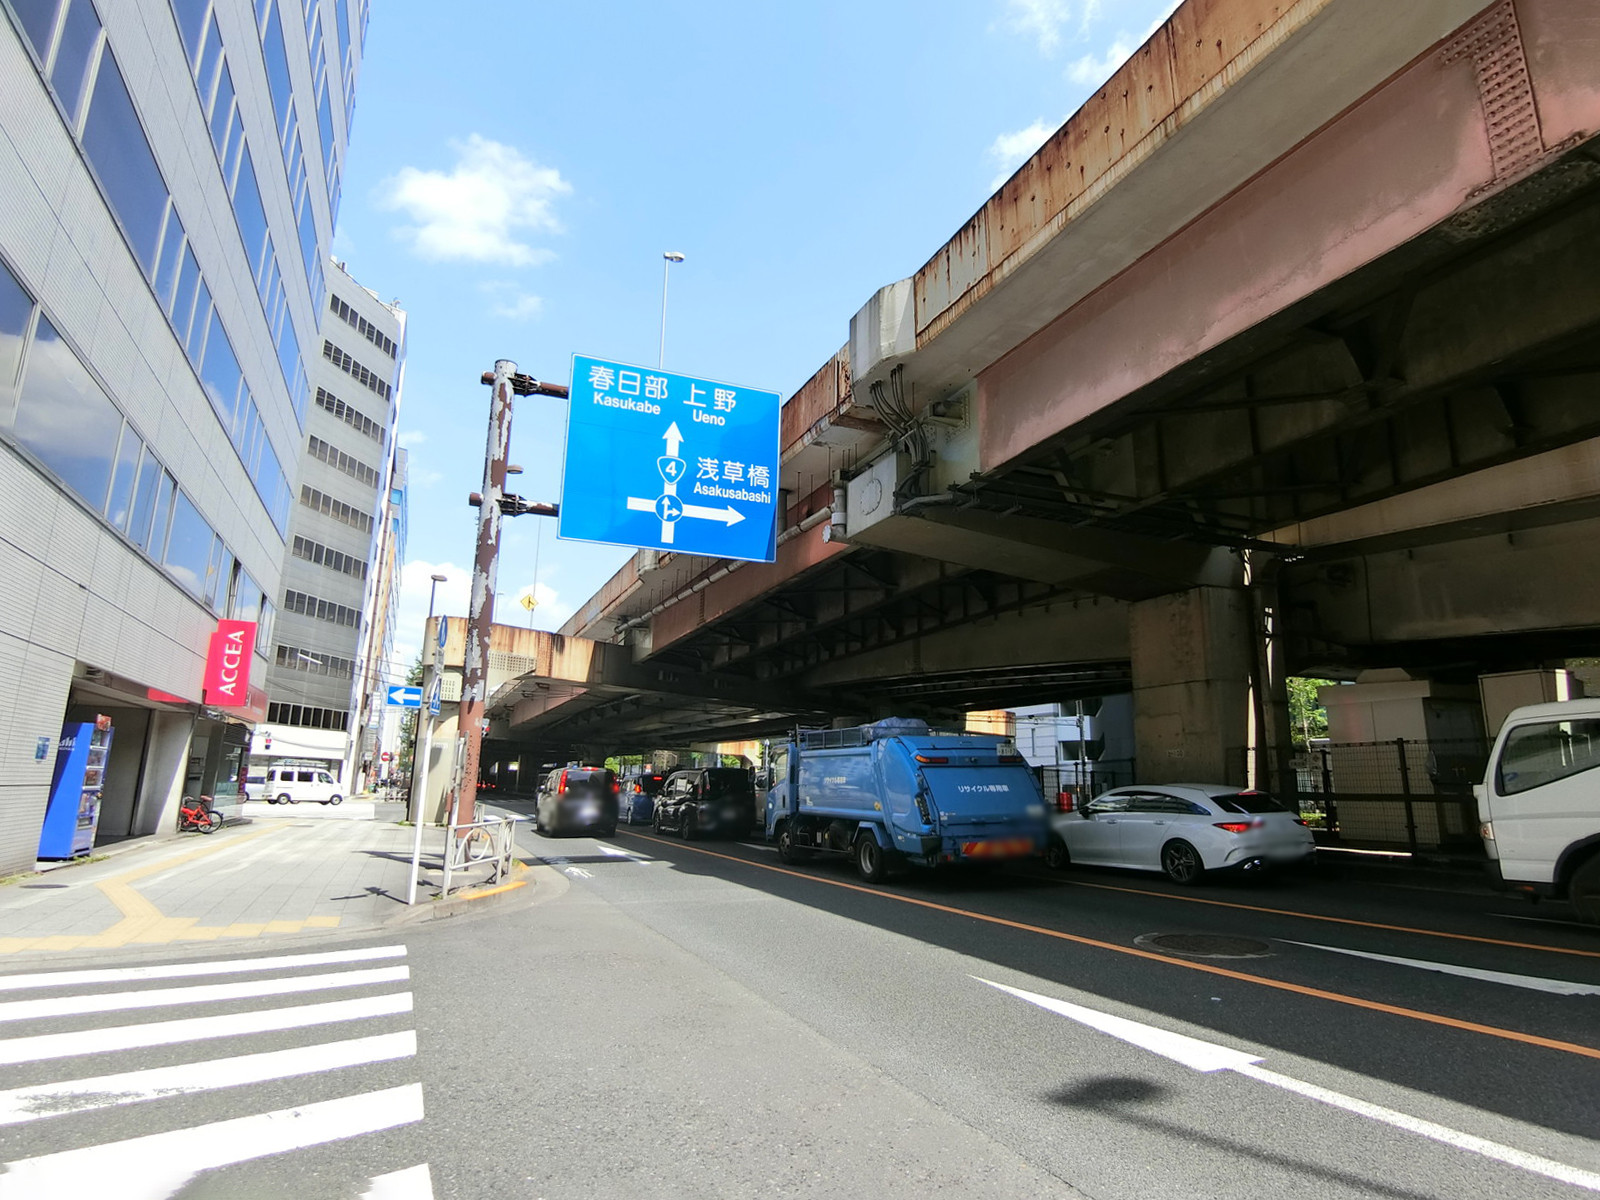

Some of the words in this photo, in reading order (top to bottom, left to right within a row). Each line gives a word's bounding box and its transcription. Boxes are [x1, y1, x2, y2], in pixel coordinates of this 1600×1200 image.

[588, 365, 668, 400] 春日部
[593, 391, 661, 415] Kasukabe
[683, 383, 736, 412] 上野
[692, 409, 726, 426] Ueno
[665, 460, 677, 477] 4
[696, 457, 770, 488] 浅草橋
[693, 481, 771, 504] Asakusabashi
[219, 630, 245, 696] ACCEA
